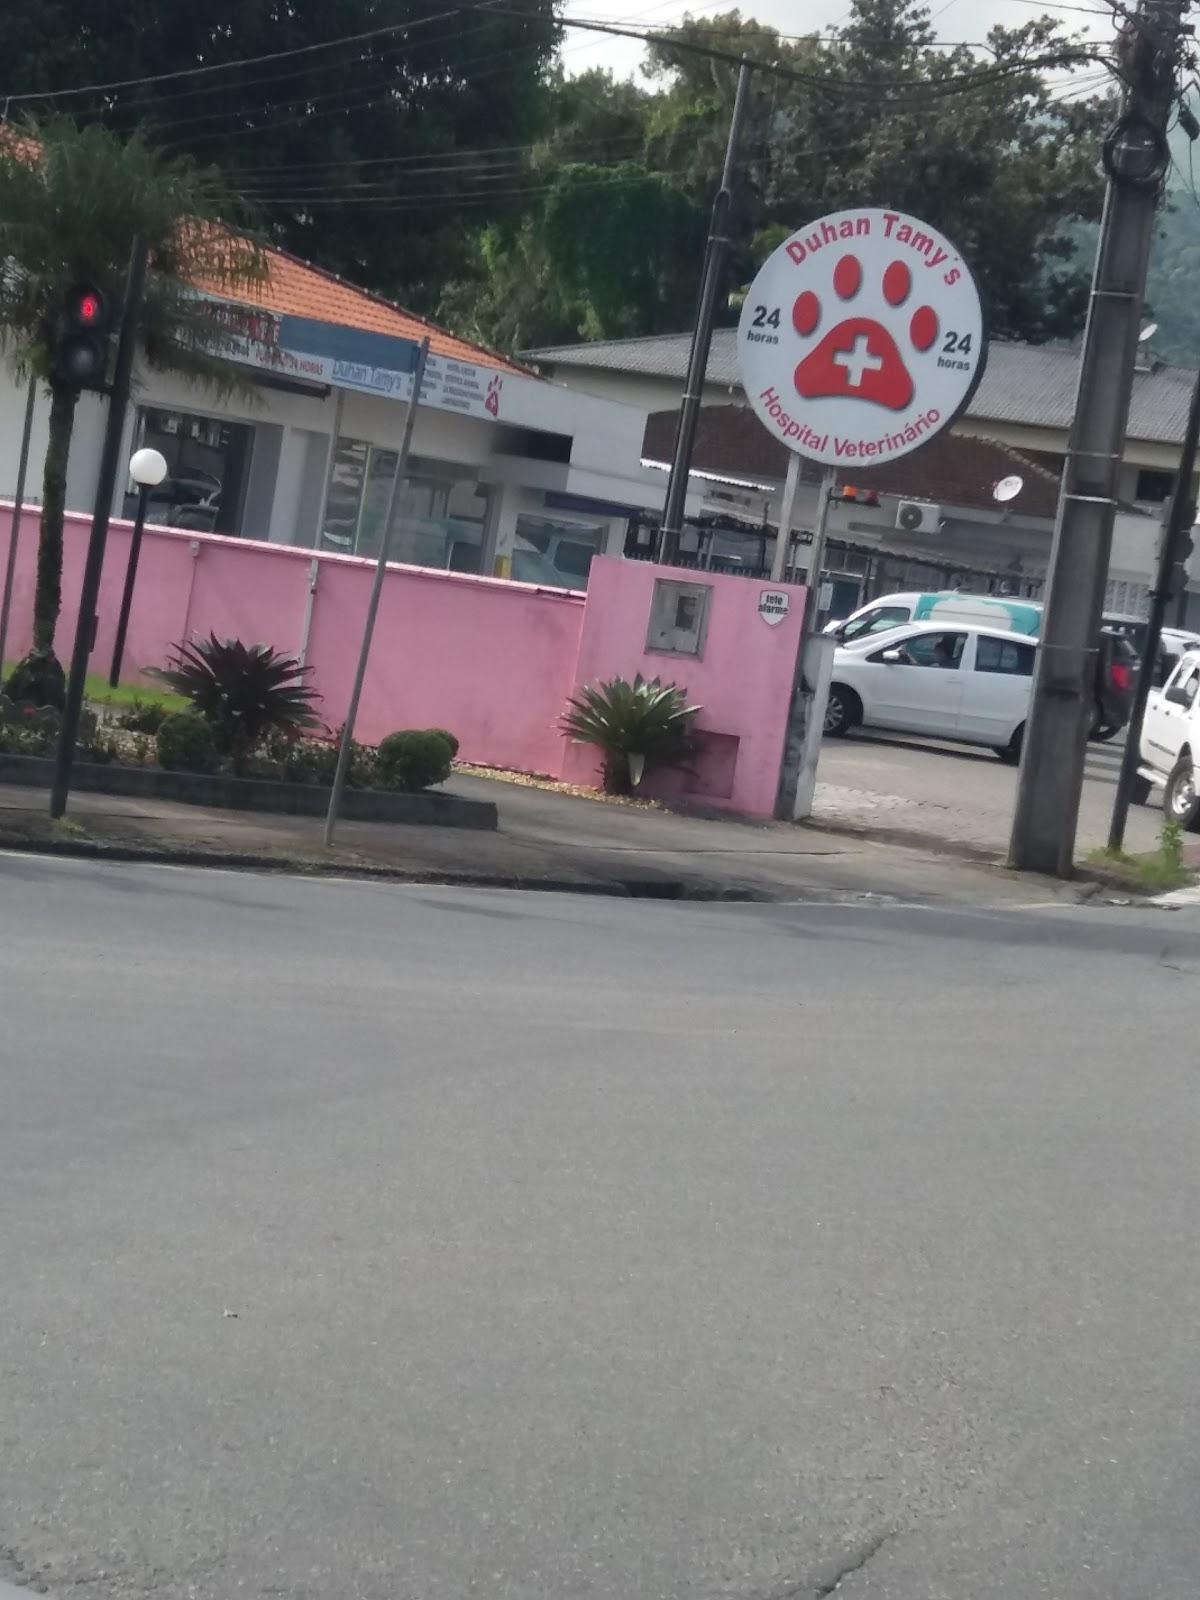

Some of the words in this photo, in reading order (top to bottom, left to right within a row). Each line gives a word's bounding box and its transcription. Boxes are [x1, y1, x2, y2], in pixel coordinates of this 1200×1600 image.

[785, 217, 871, 266] Duhan
[752, 305, 781, 329] 24
[747, 330, 779, 345] horas
[942, 331, 972, 355] 24
[937, 356, 970, 371] horas
[760, 386, 829, 453] Hospital
[834, 408, 941, 457] Veterinário
[758, 603, 788, 615] alarme
[766, 594, 782, 605] tele
